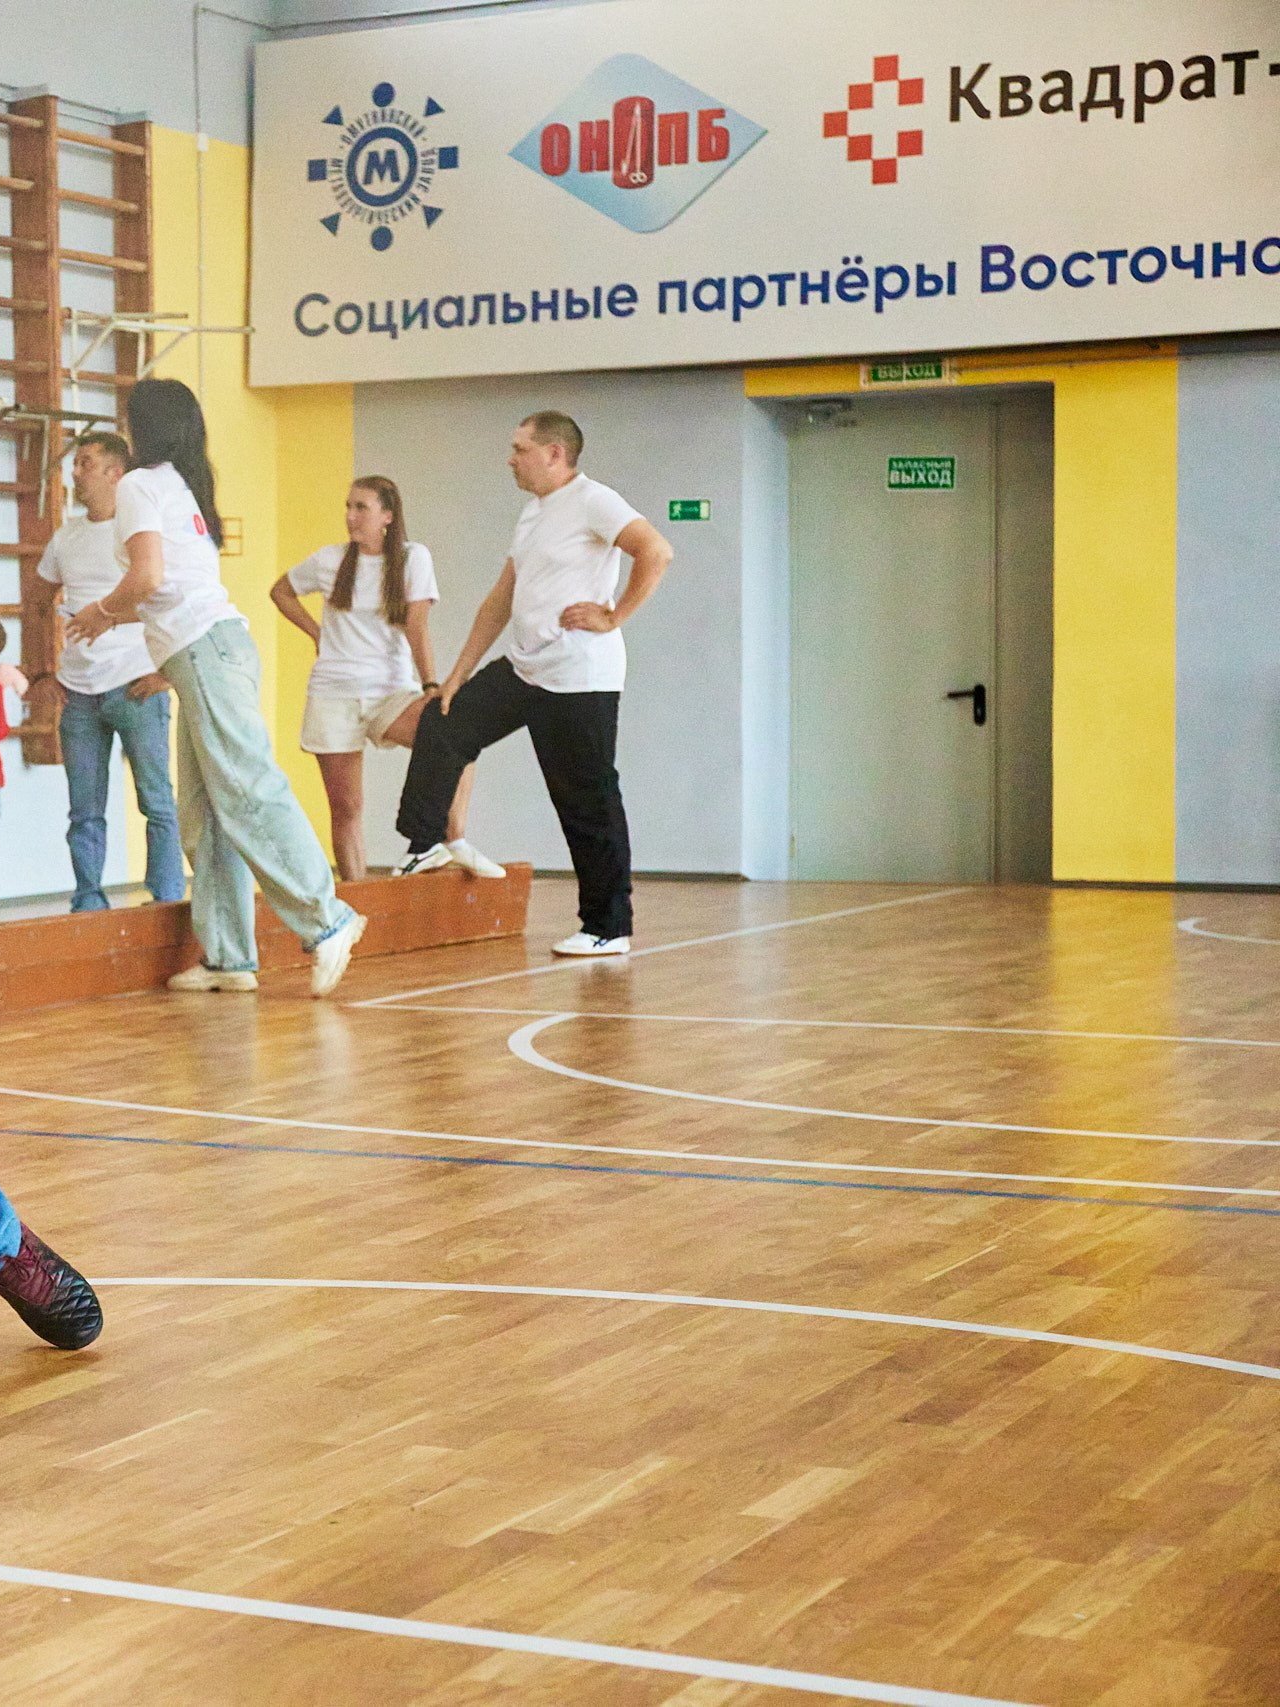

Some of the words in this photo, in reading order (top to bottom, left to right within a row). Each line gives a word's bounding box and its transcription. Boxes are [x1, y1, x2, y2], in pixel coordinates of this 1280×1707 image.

[294, 282, 639, 340] Социальные
[658, 255, 957, 322] партнёры
[980, 236, 1280, 293] Восточно
[890, 469, 952, 487] ВЫХОД
